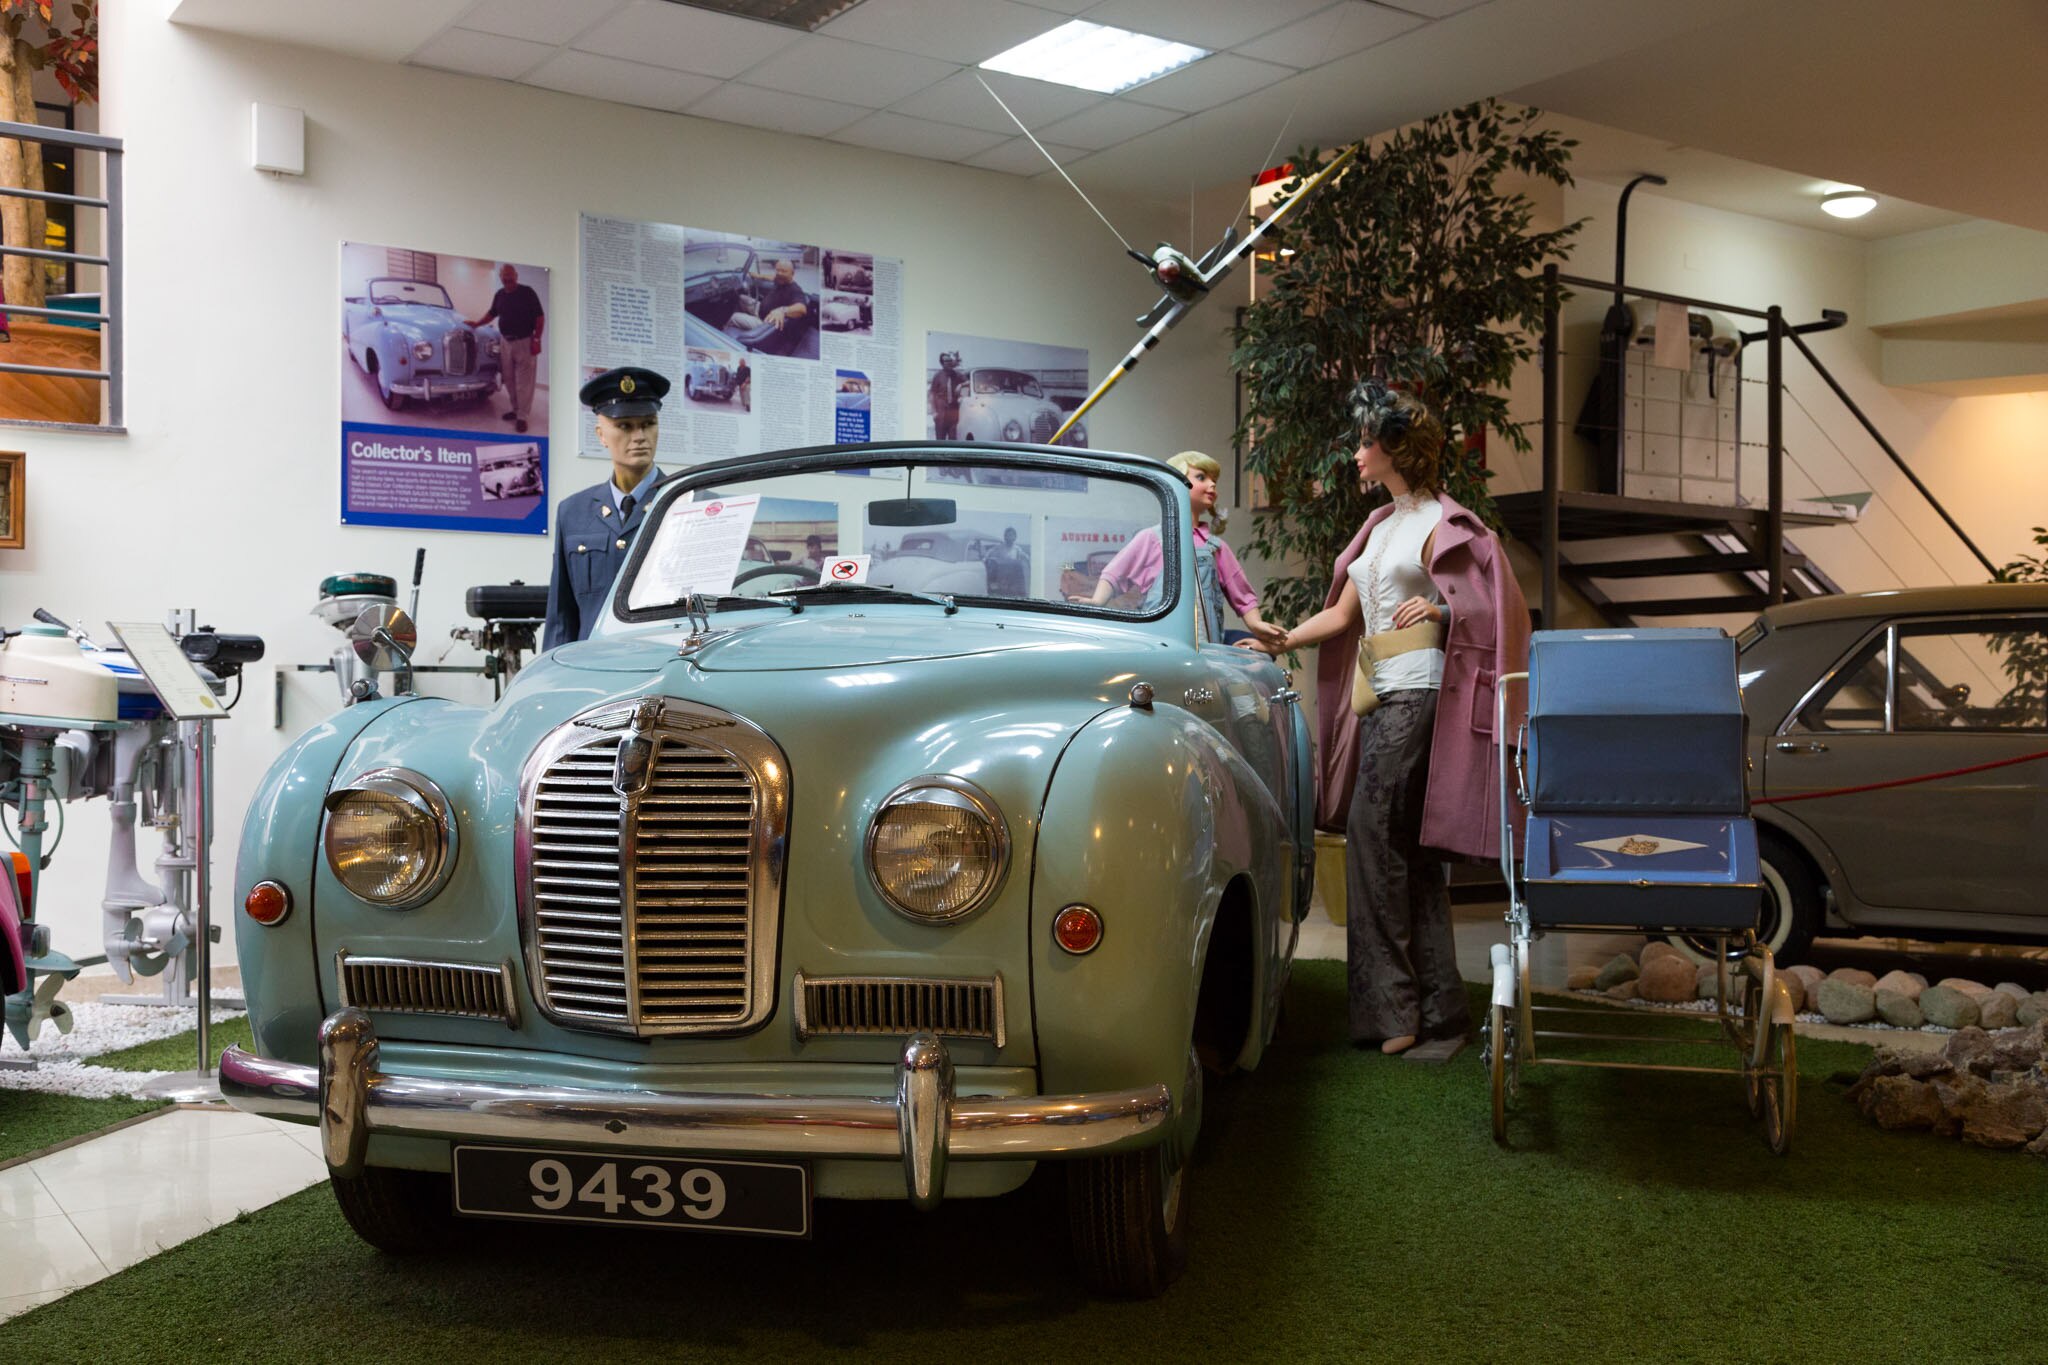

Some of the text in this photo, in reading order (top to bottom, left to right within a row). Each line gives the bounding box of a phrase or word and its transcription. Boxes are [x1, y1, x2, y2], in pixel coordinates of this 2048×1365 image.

[351, 441, 472, 465] Collector's Item
[1061, 532, 1099, 543] AUSTIN
[529, 1159, 727, 1220] 9439
